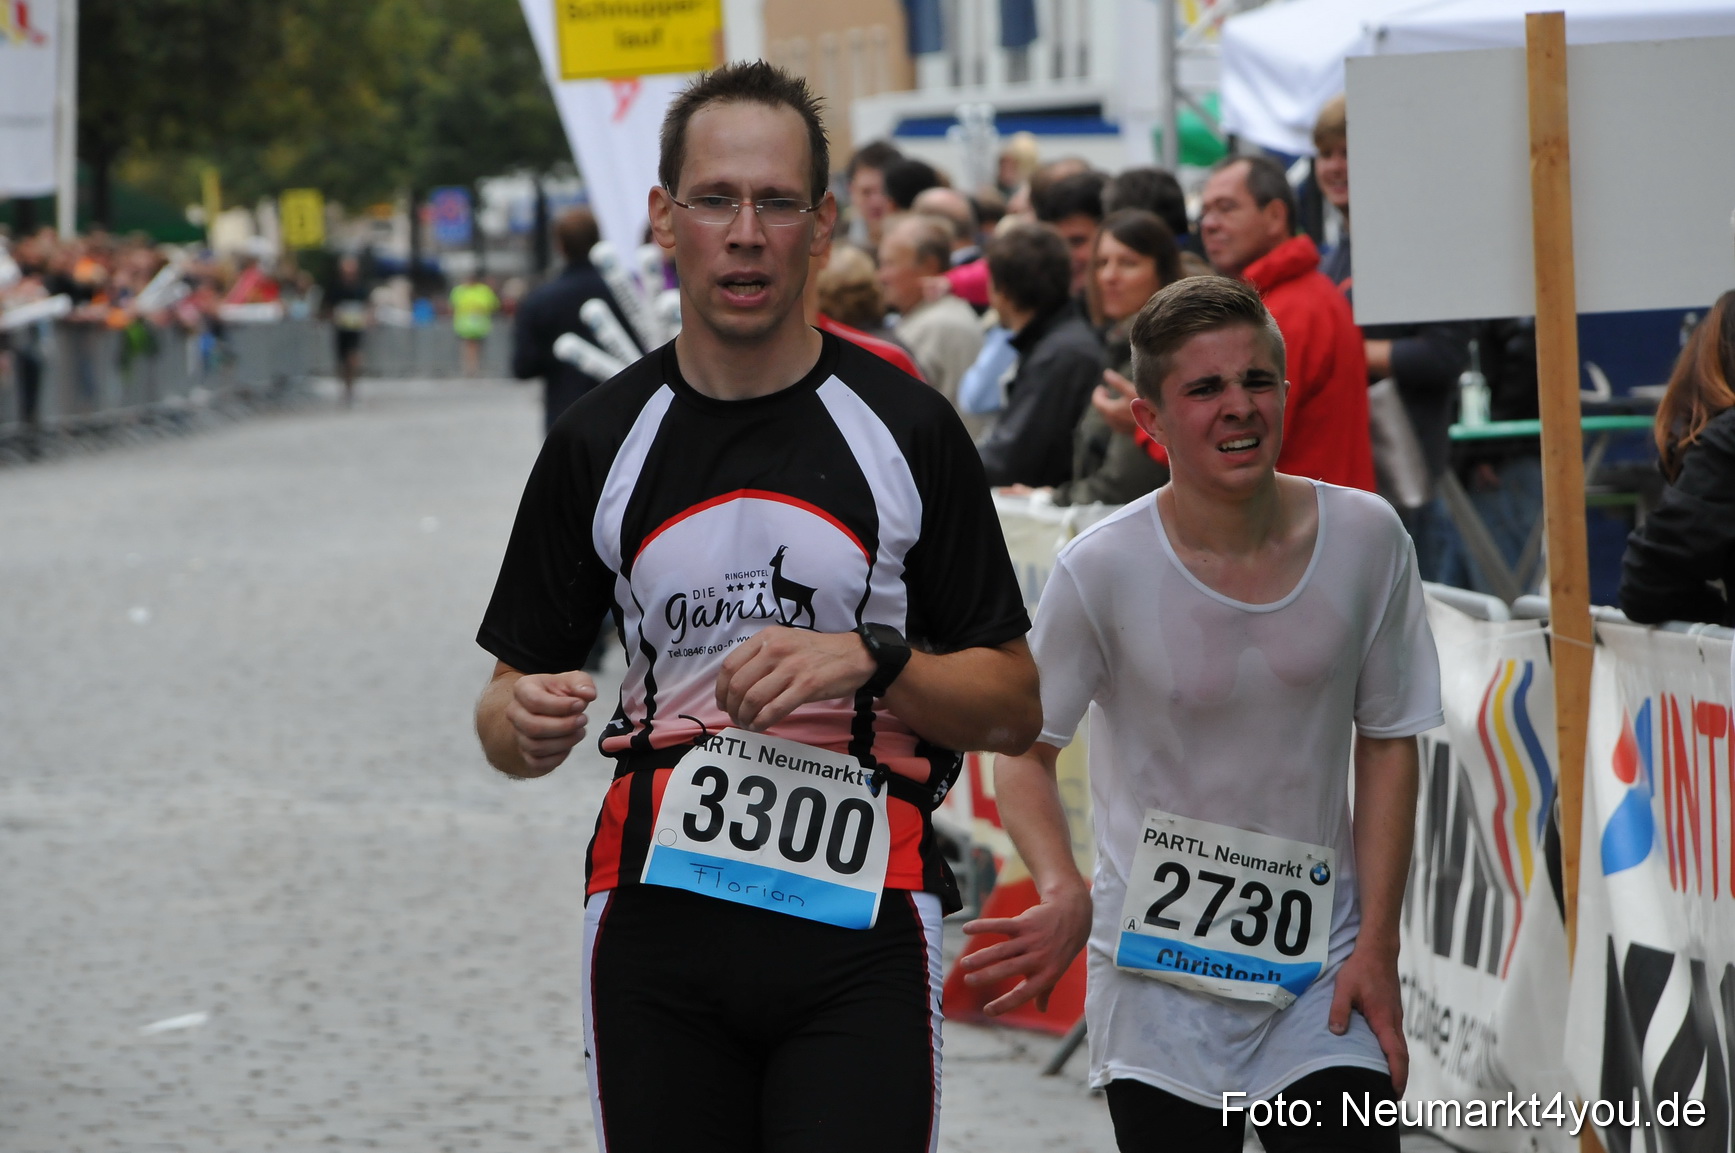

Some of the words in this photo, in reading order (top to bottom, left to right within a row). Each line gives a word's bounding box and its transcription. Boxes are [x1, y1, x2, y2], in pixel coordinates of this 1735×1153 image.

[614, 27, 665, 50] lauf
[692, 586, 716, 600] DIE
[724, 569, 769, 581] RINGHOTEL
[758, 744, 865, 786] Neumarkt
[682, 765, 875, 875] 3300
[1143, 828, 1209, 859] PARTL
[1214, 845, 1303, 879] Neumarkt
[689, 863, 806, 907] Florian
[1127, 918, 1136, 931] A
[1144, 861, 1313, 957] 2730
